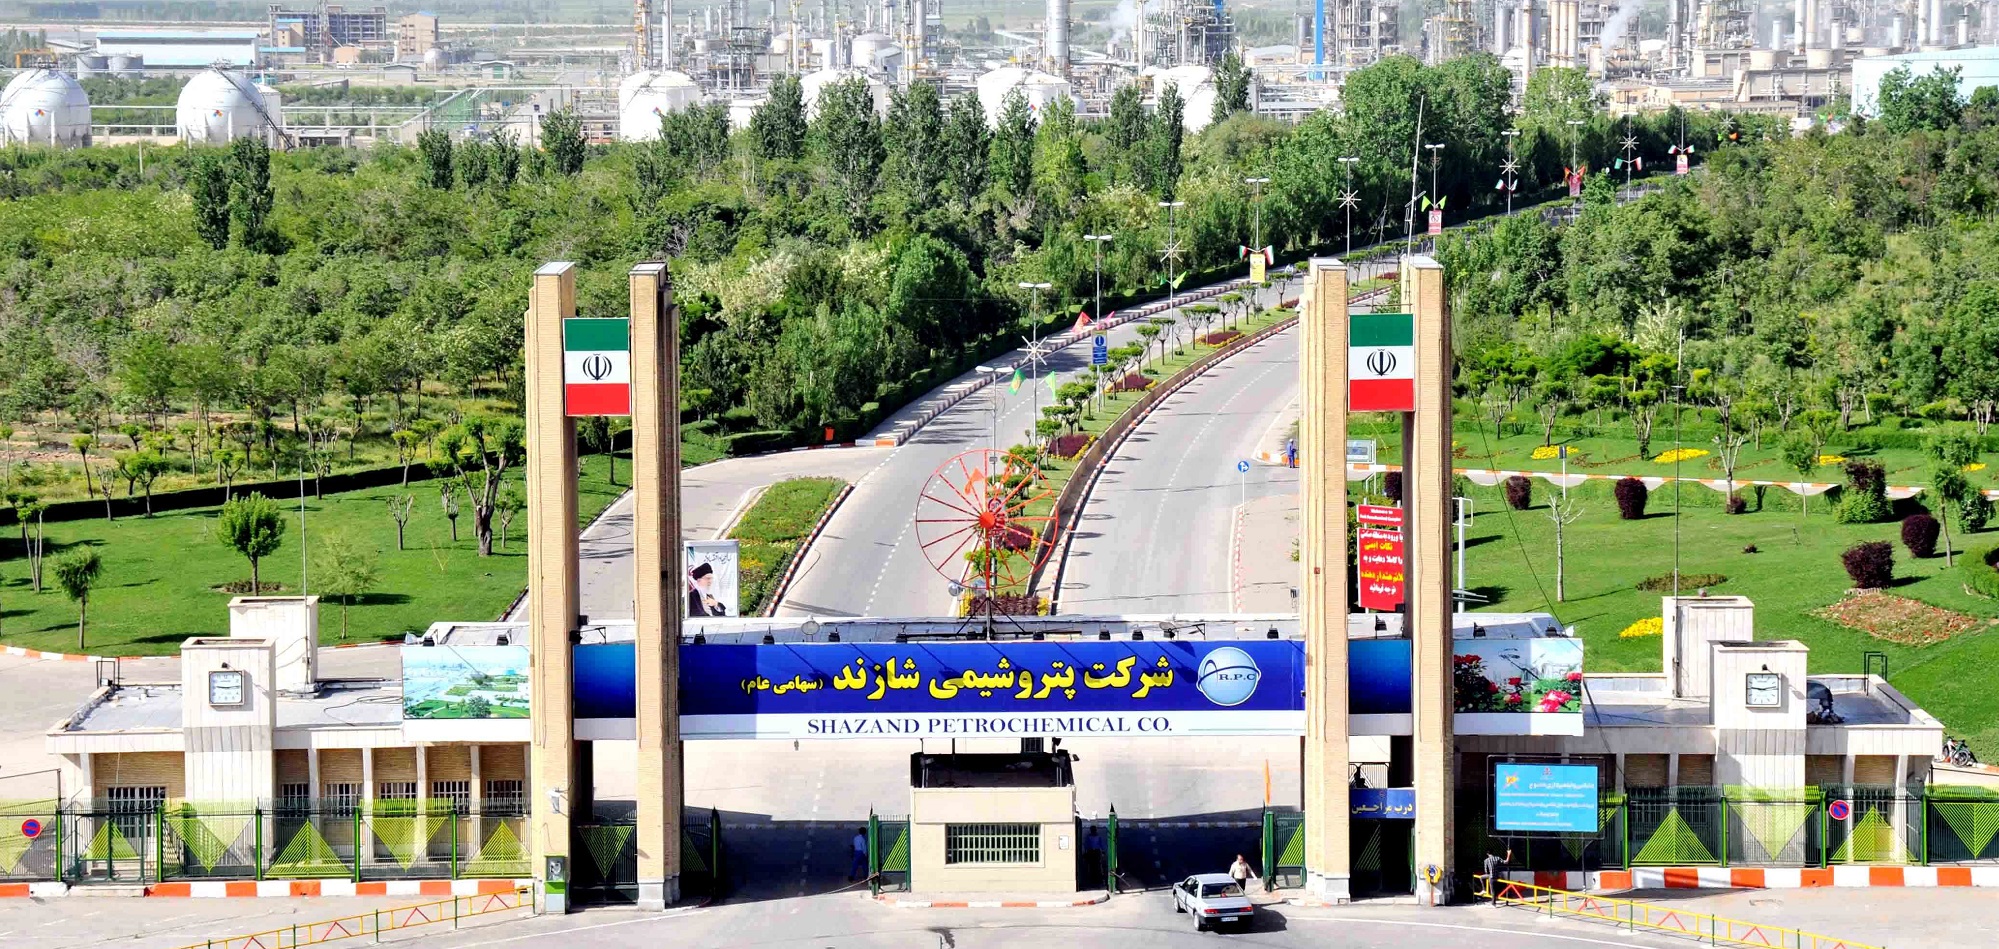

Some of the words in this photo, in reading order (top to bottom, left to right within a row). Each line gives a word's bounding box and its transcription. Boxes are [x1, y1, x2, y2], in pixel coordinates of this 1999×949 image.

[1380, 542, 1393, 551] نکات
[832, 656, 921, 700] شازند
[929, 656, 1076, 700] پتروشیمی
[1083, 655, 1175, 699] شرکت
[807, 718, 920, 734] SHAZAND
[928, 716, 1131, 734] PETROCHEMICAL
[1137, 716, 1173, 732] CO.
[1352, 802, 1392, 814] مراجعین
[1394, 803, 1412, 814] درب
